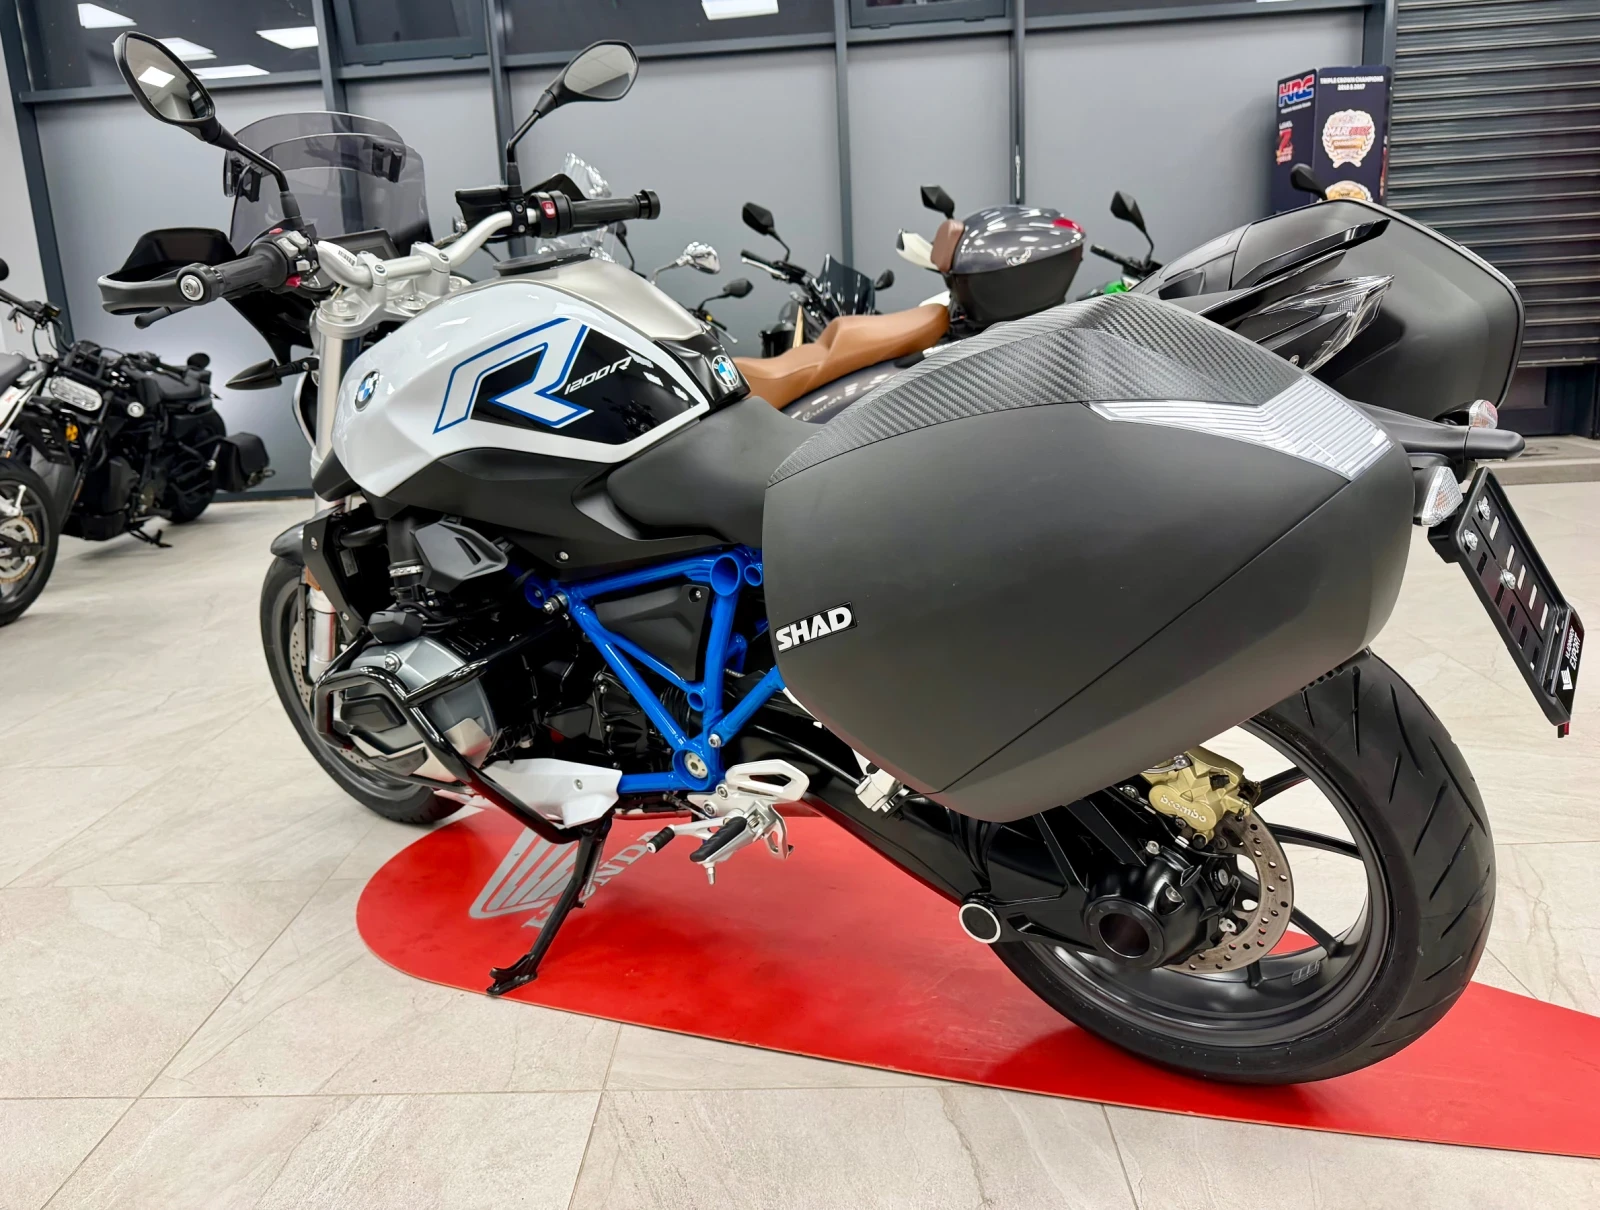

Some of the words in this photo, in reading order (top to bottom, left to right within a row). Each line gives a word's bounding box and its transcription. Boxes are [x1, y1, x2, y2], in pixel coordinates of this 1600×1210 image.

[1279, 74, 1314, 107] HRC
[775, 606, 852, 651] SHAD
[1570, 632, 1581, 670] EXPORT
[1160, 794, 1207, 823] brembo
